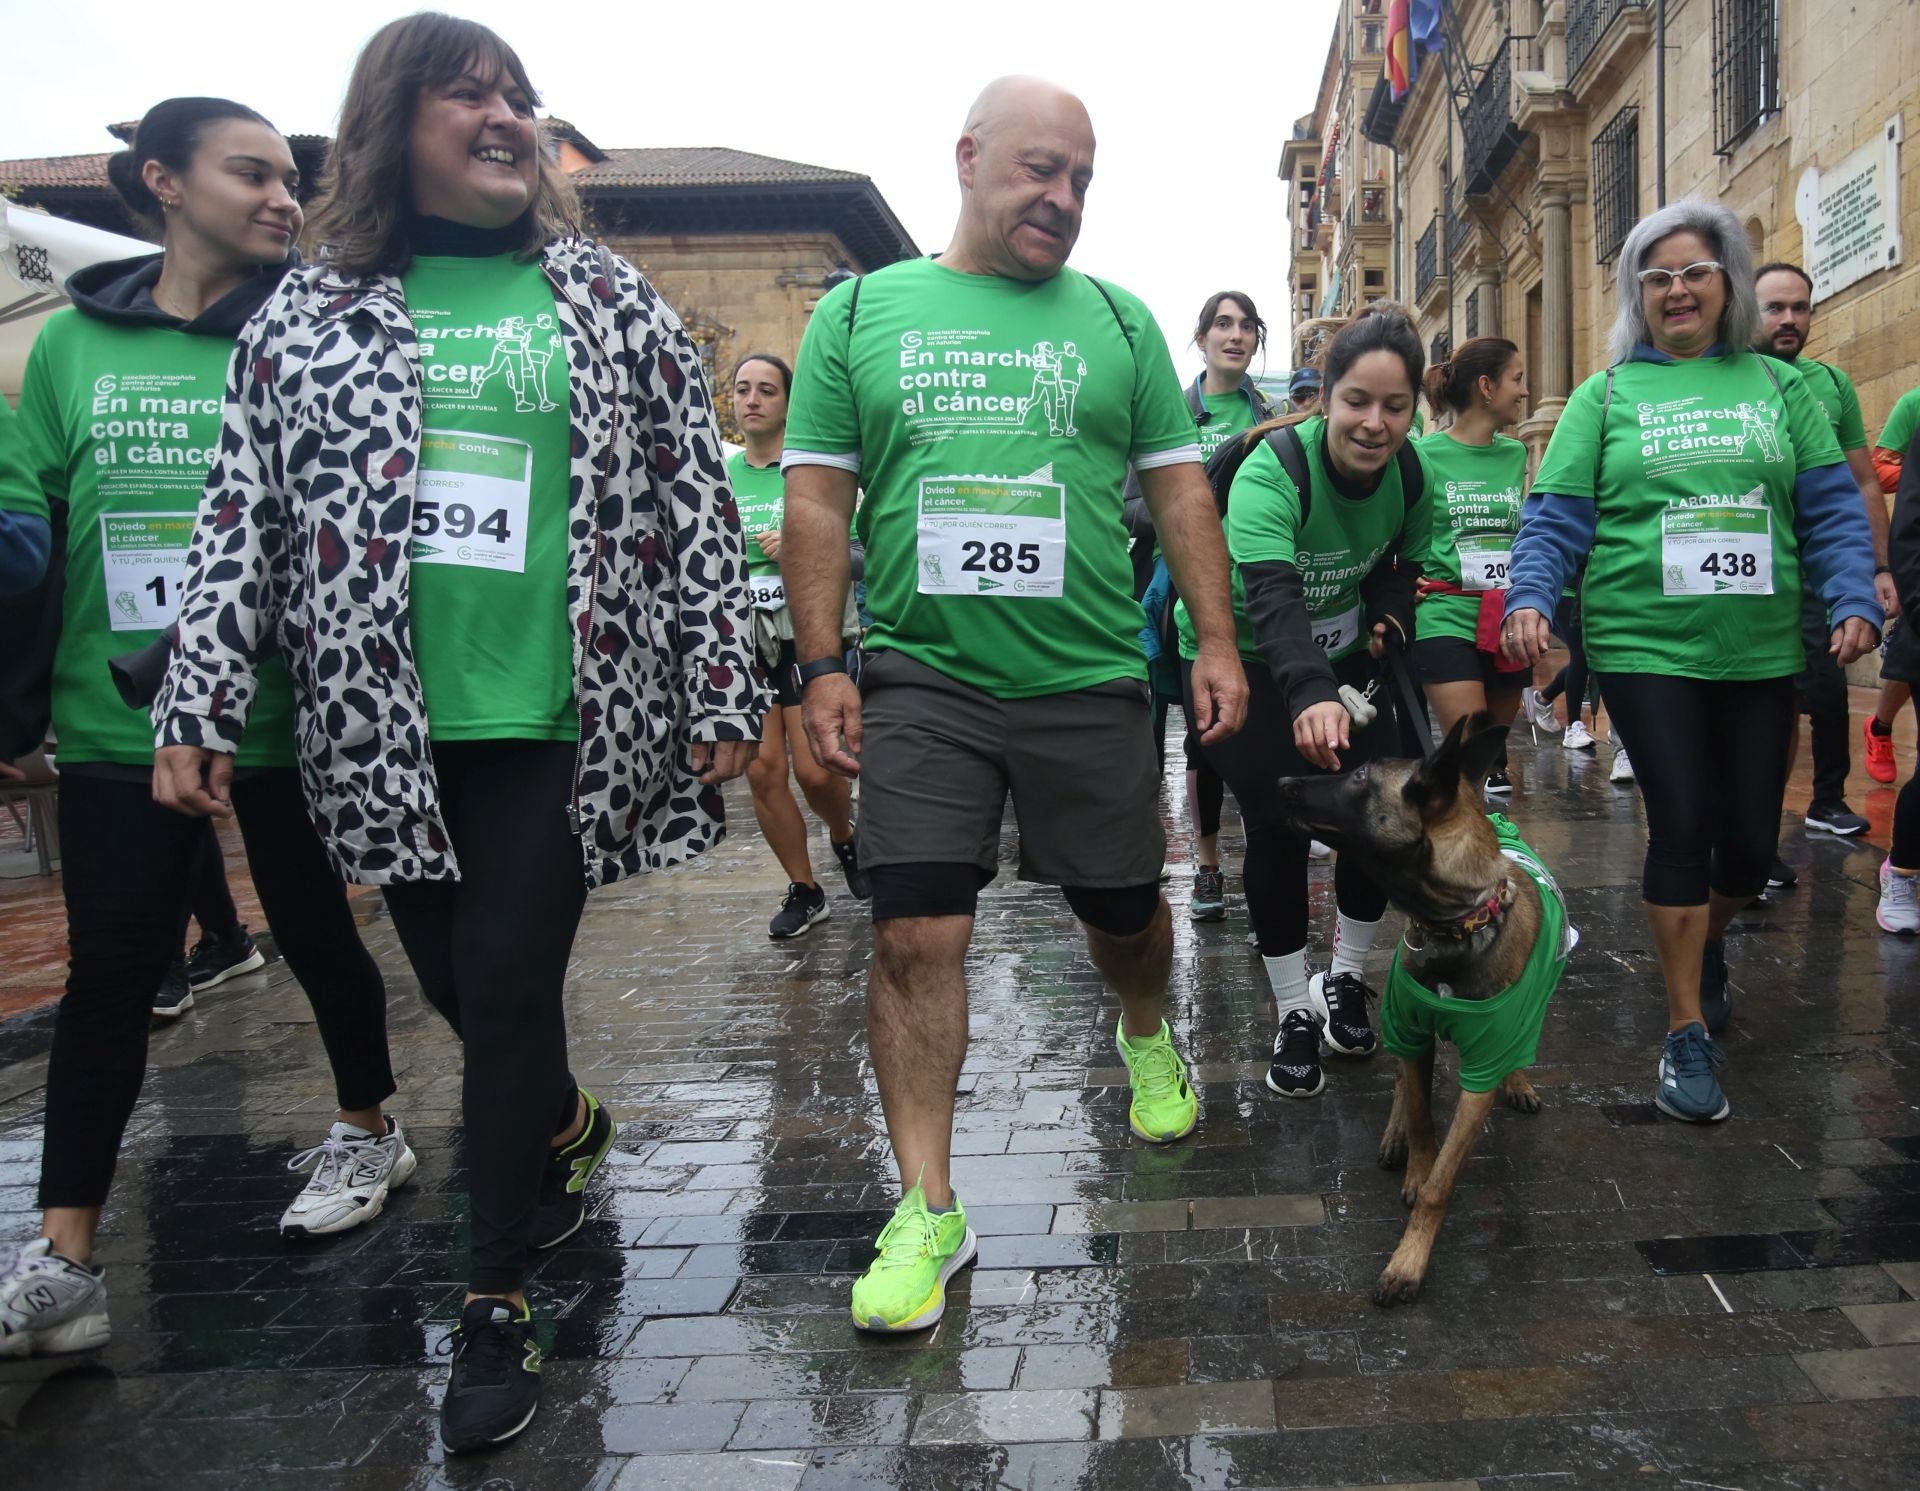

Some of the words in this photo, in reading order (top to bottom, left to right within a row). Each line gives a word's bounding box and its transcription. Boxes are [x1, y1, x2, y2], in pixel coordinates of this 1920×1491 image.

[900, 349, 934, 368] En
[944, 349, 1046, 368] marcha
[900, 368, 986, 390] contra
[92, 395, 128, 416] En
[902, 391, 924, 416] el
[933, 391, 1027, 412] cáncer
[1639, 413, 1665, 427] En
[1672, 408, 1750, 423] marcha
[91, 417, 189, 440] contra
[1640, 422, 1708, 441] contra
[94, 441, 117, 465] el
[459, 443, 499, 456] contra
[1641, 439, 1660, 457] el
[1667, 434, 1742, 451] cáncer
[924, 498, 934, 506] el
[934, 497, 966, 506] cáncer
[925, 486, 955, 495] Oviedo
[972, 486, 1009, 496] marcha
[1011, 489, 1042, 498] contra
[1447, 493, 1465, 503] En
[1469, 492, 1513, 503] marcha
[1669, 494, 1737, 509] LABORAL
[1449, 504, 1490, 516] contra
[1667, 512, 1695, 521] Oviedo
[1735, 511, 1756, 519] contra
[109, 522, 146, 531] Oviedo
[412, 501, 511, 544] 594
[1451, 516, 1462, 528] el
[1465, 515, 1508, 528] cáncer
[1667, 521, 1676, 529] el
[1676, 520, 1703, 528] cáncer
[110, 535, 120, 543] el
[122, 534, 159, 543] cáncer
[154, 556, 179, 564] QUIÉN
[961, 541, 1040, 574] 285
[1699, 552, 1757, 577] 438
[1484, 563, 1511, 579] 20
[146, 576, 183, 607] 1
[1314, 629, 1342, 650] 92
